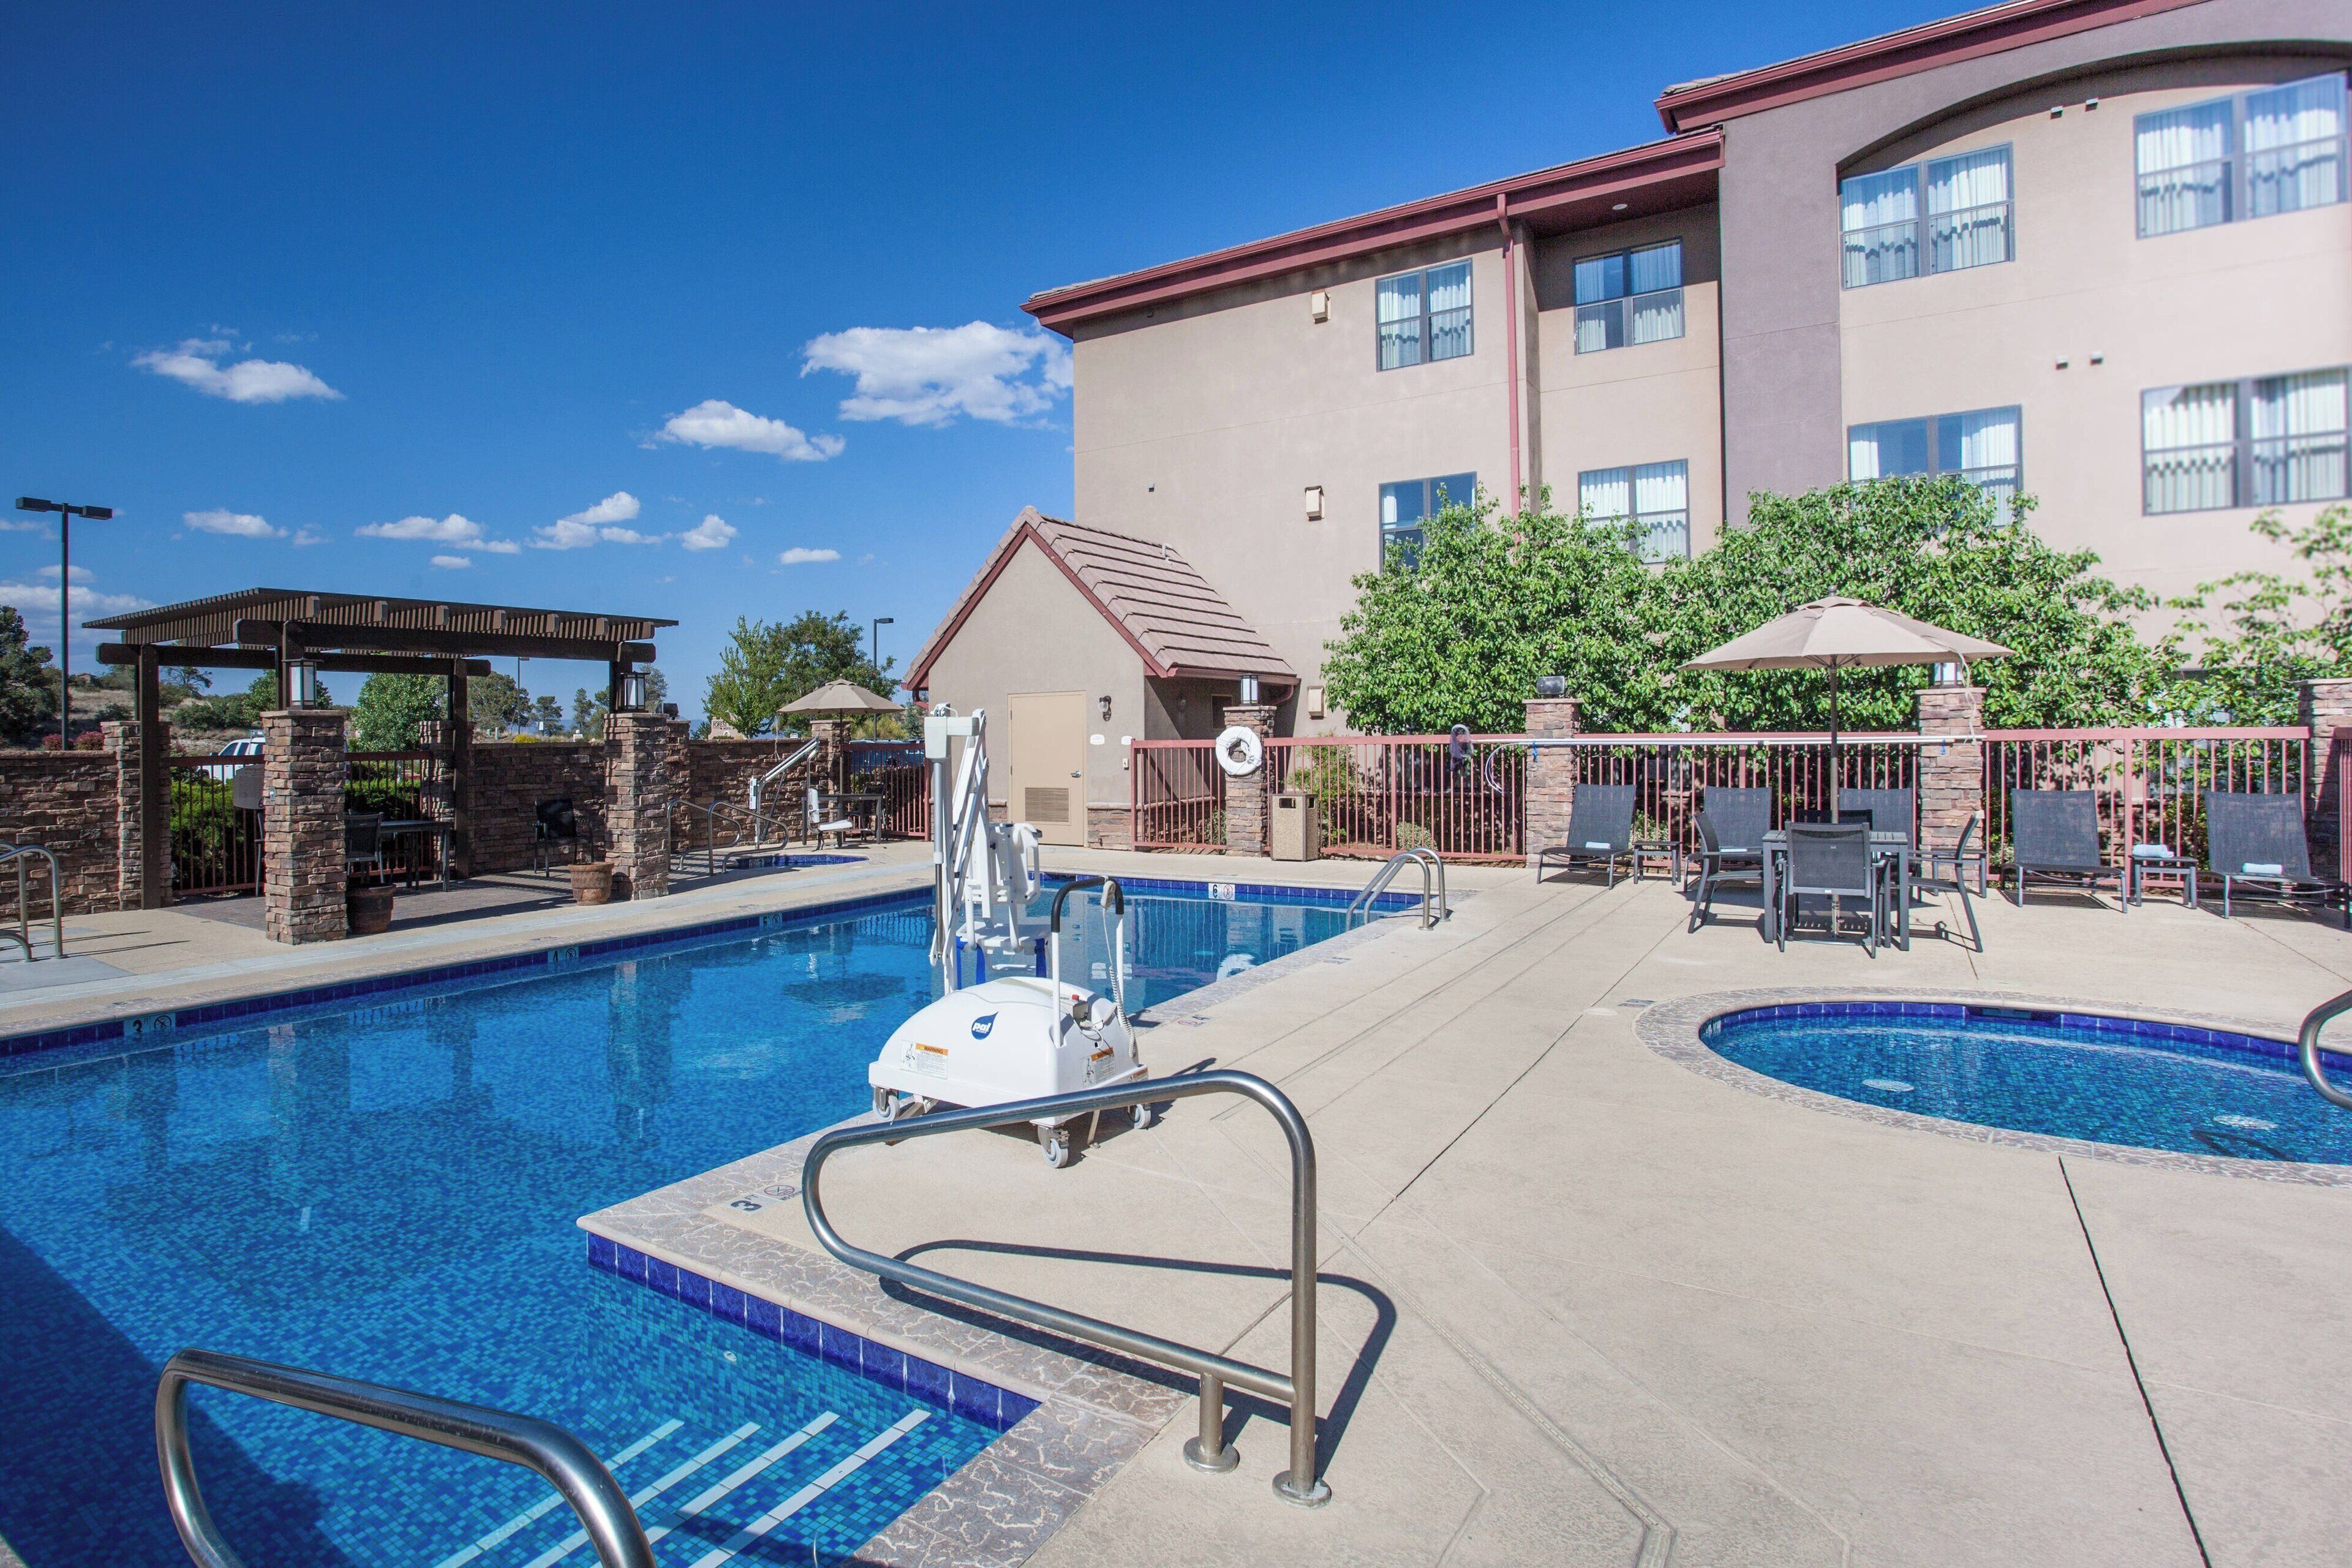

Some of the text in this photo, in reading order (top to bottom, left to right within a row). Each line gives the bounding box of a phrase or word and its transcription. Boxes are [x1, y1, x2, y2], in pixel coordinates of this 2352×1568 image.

[972, 1022, 992, 1032] pal
[924, 1044, 944, 1054] WARNING
[730, 1200, 762, 1212] 3
